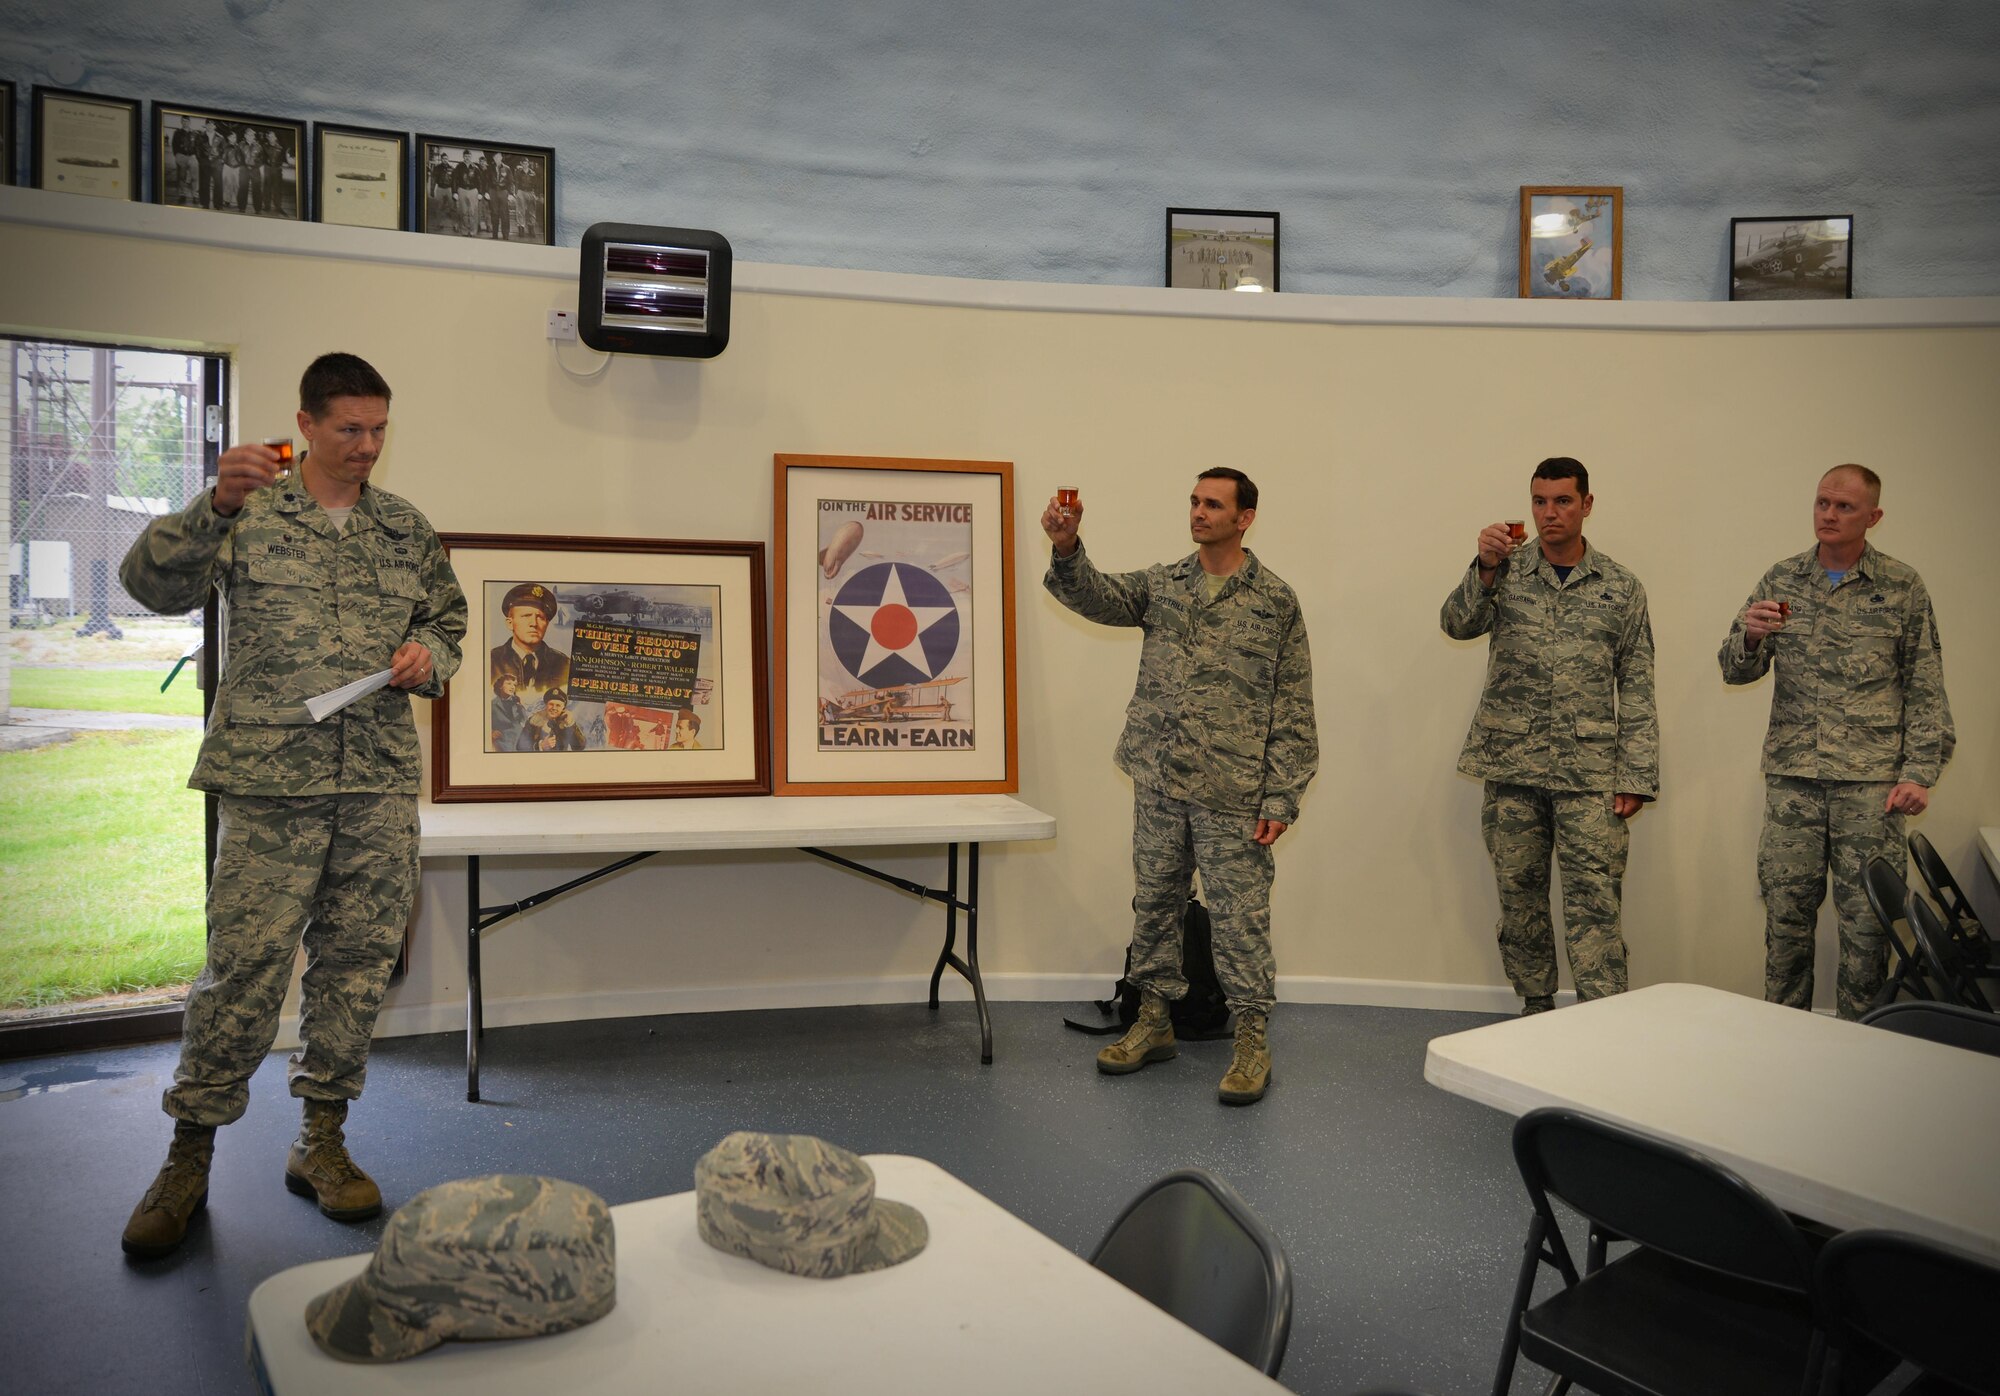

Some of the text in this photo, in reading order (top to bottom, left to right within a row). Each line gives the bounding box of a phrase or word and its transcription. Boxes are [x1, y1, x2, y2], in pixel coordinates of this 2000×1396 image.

[819, 502, 971, 523] JOIN THE AIR SERVICE
[267, 544, 306, 559] WEBSTER
[380, 559, 393, 568] U.S.
[394, 559, 404, 569] AIR
[1154, 594, 1184, 613] COTTRILL
[1608, 604, 1624, 613] FORCE
[575, 628, 697, 651] THIRTY SECONDS
[1236, 620, 1280, 640] U.S. AIR FORCE
[592, 641, 681, 659] OVER TOKYO
[572, 655, 588, 663] VAN
[588, 656, 626, 667] JOHNSON
[631, 662, 662, 671] ROBERT
[664, 665, 694, 674] WALKER
[571, 677, 639, 693] SPENCER
[644, 684, 692, 699] TRACY
[819, 727, 973, 747] LEARN-EARN
